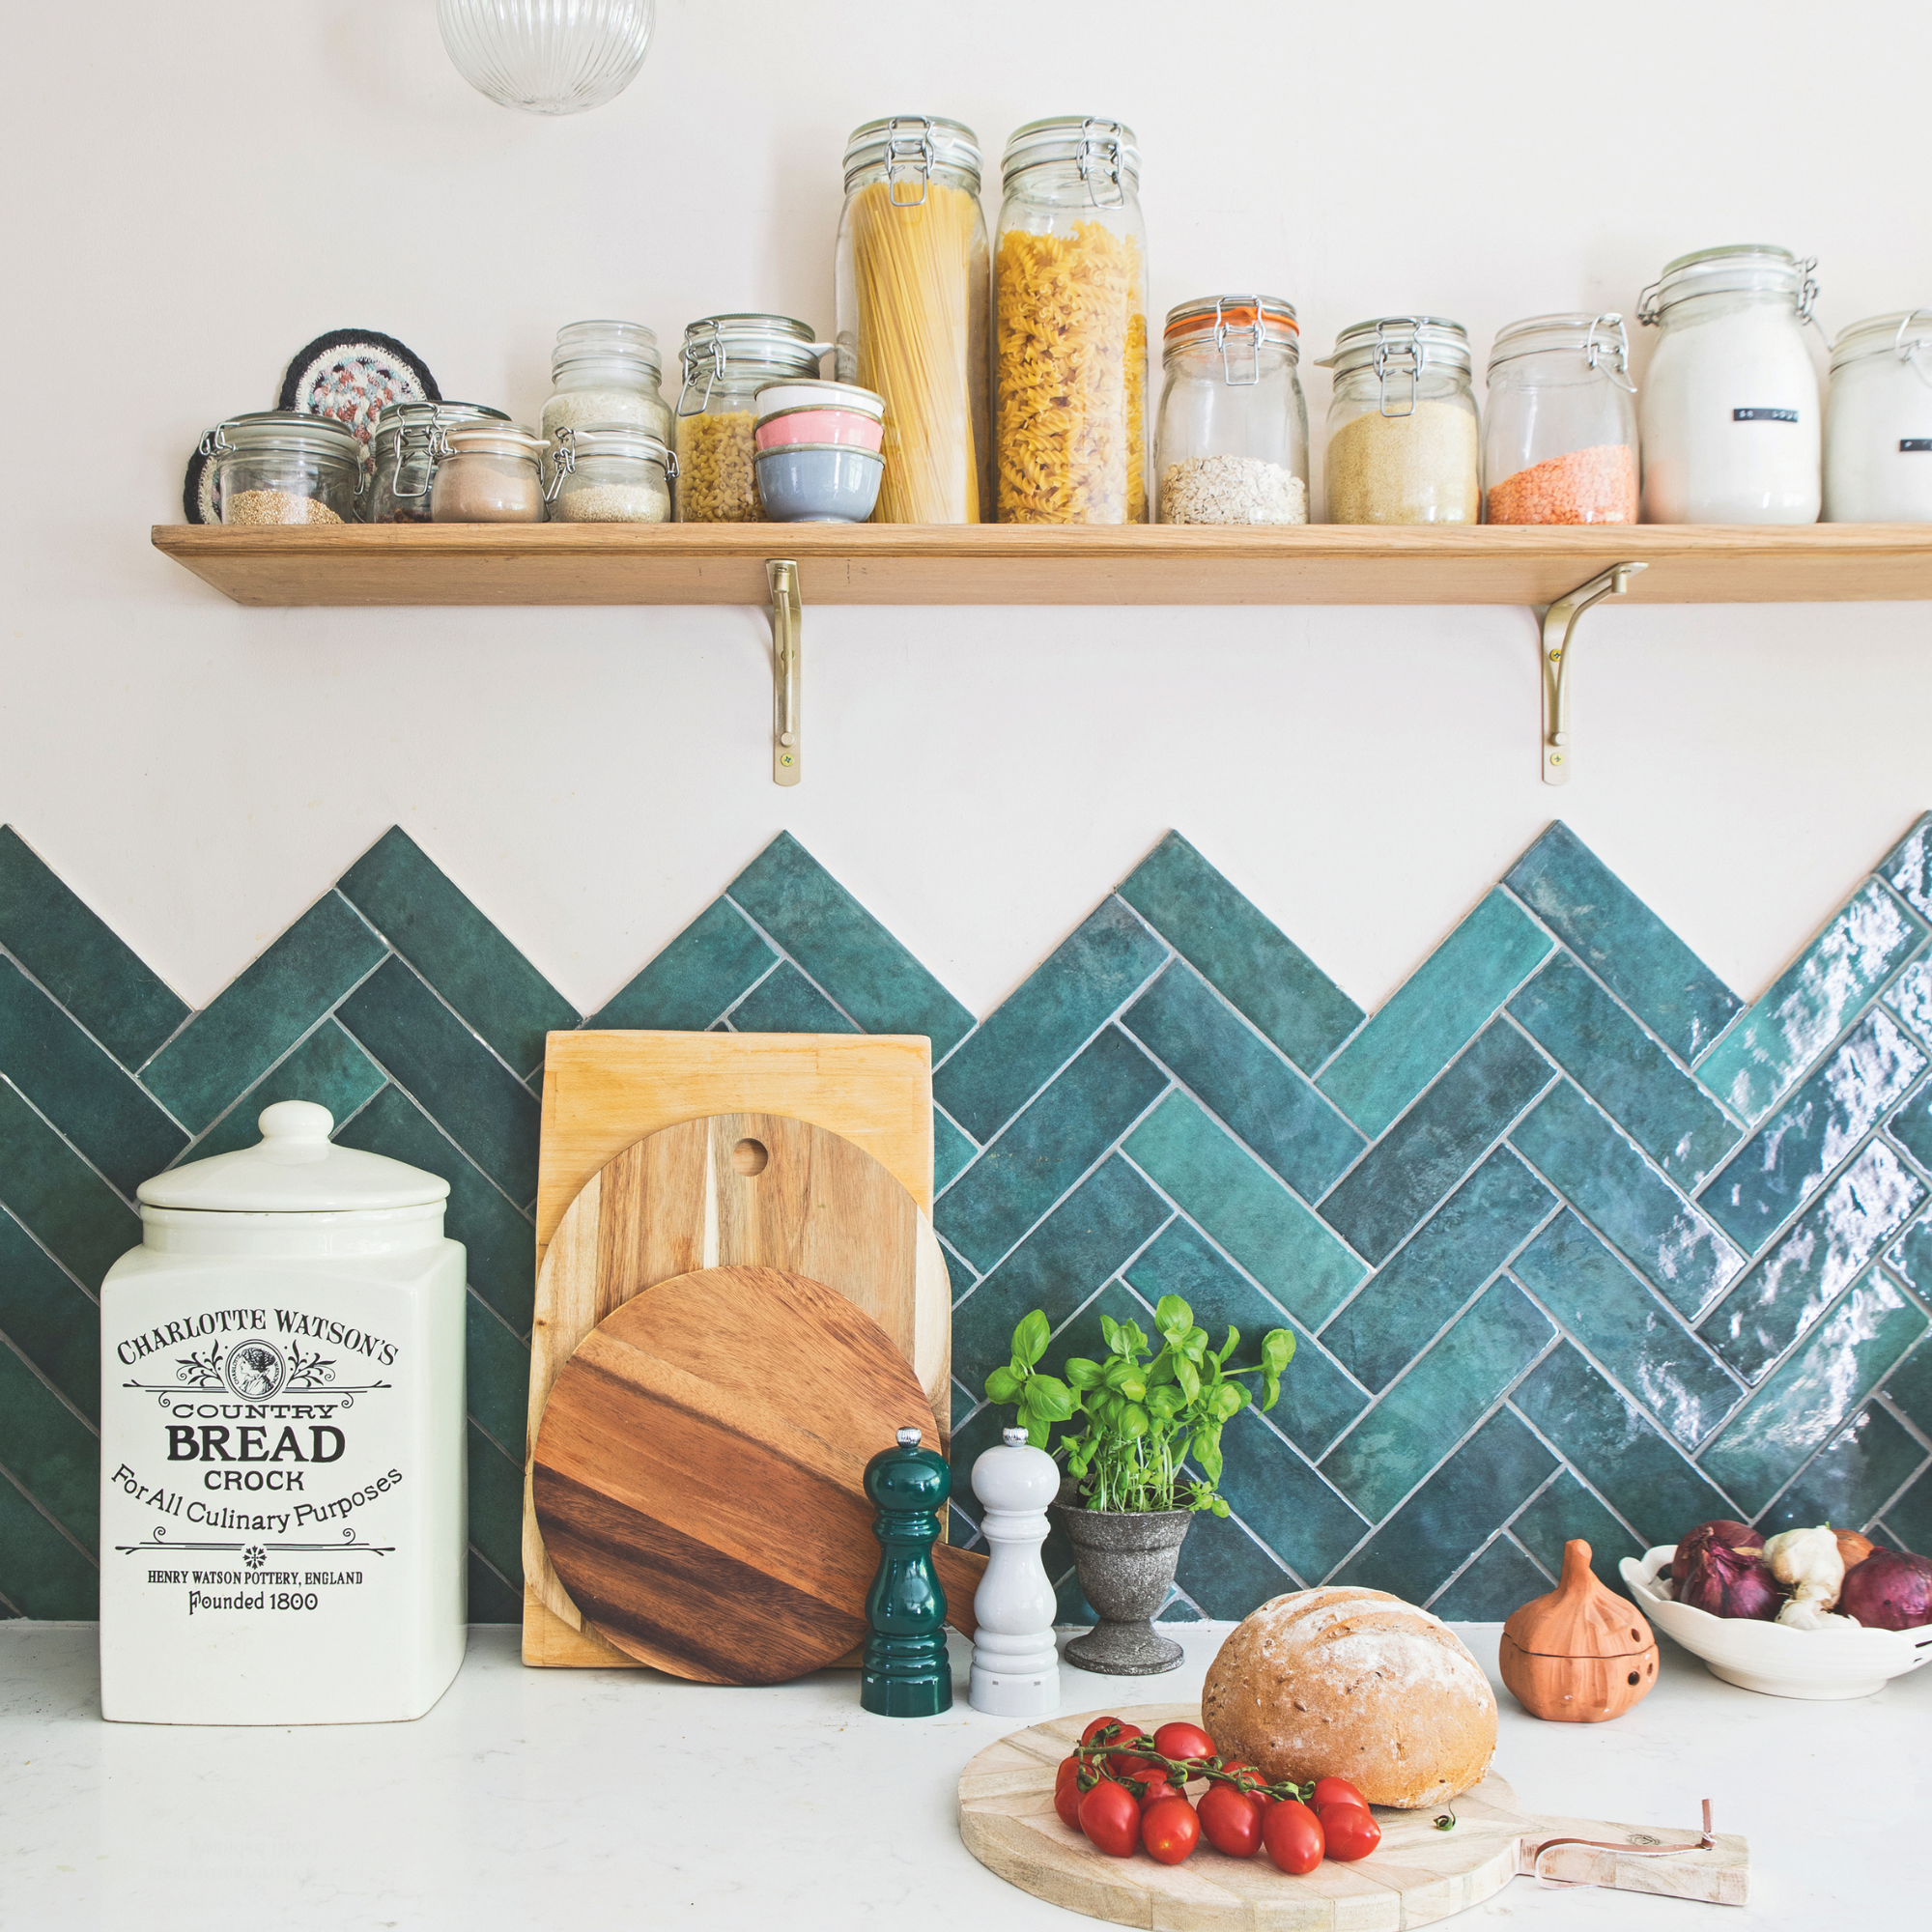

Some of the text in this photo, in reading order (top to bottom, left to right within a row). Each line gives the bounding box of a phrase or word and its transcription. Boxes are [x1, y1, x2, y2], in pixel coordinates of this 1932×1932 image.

[117, 1308, 399, 1366] CHARLOTTE WATSON'S
[172, 1404, 338, 1419] COUNTRY
[164, 1425, 346, 1463] BREAD
[204, 1469, 304, 1491] CROCK
[110, 1463, 403, 1534] For All Culinary Purposes
[147, 1570, 363, 1588] HENRY WATSON POTTERY, ENGLAND
[188, 1590, 319, 1616] Founded 1800
